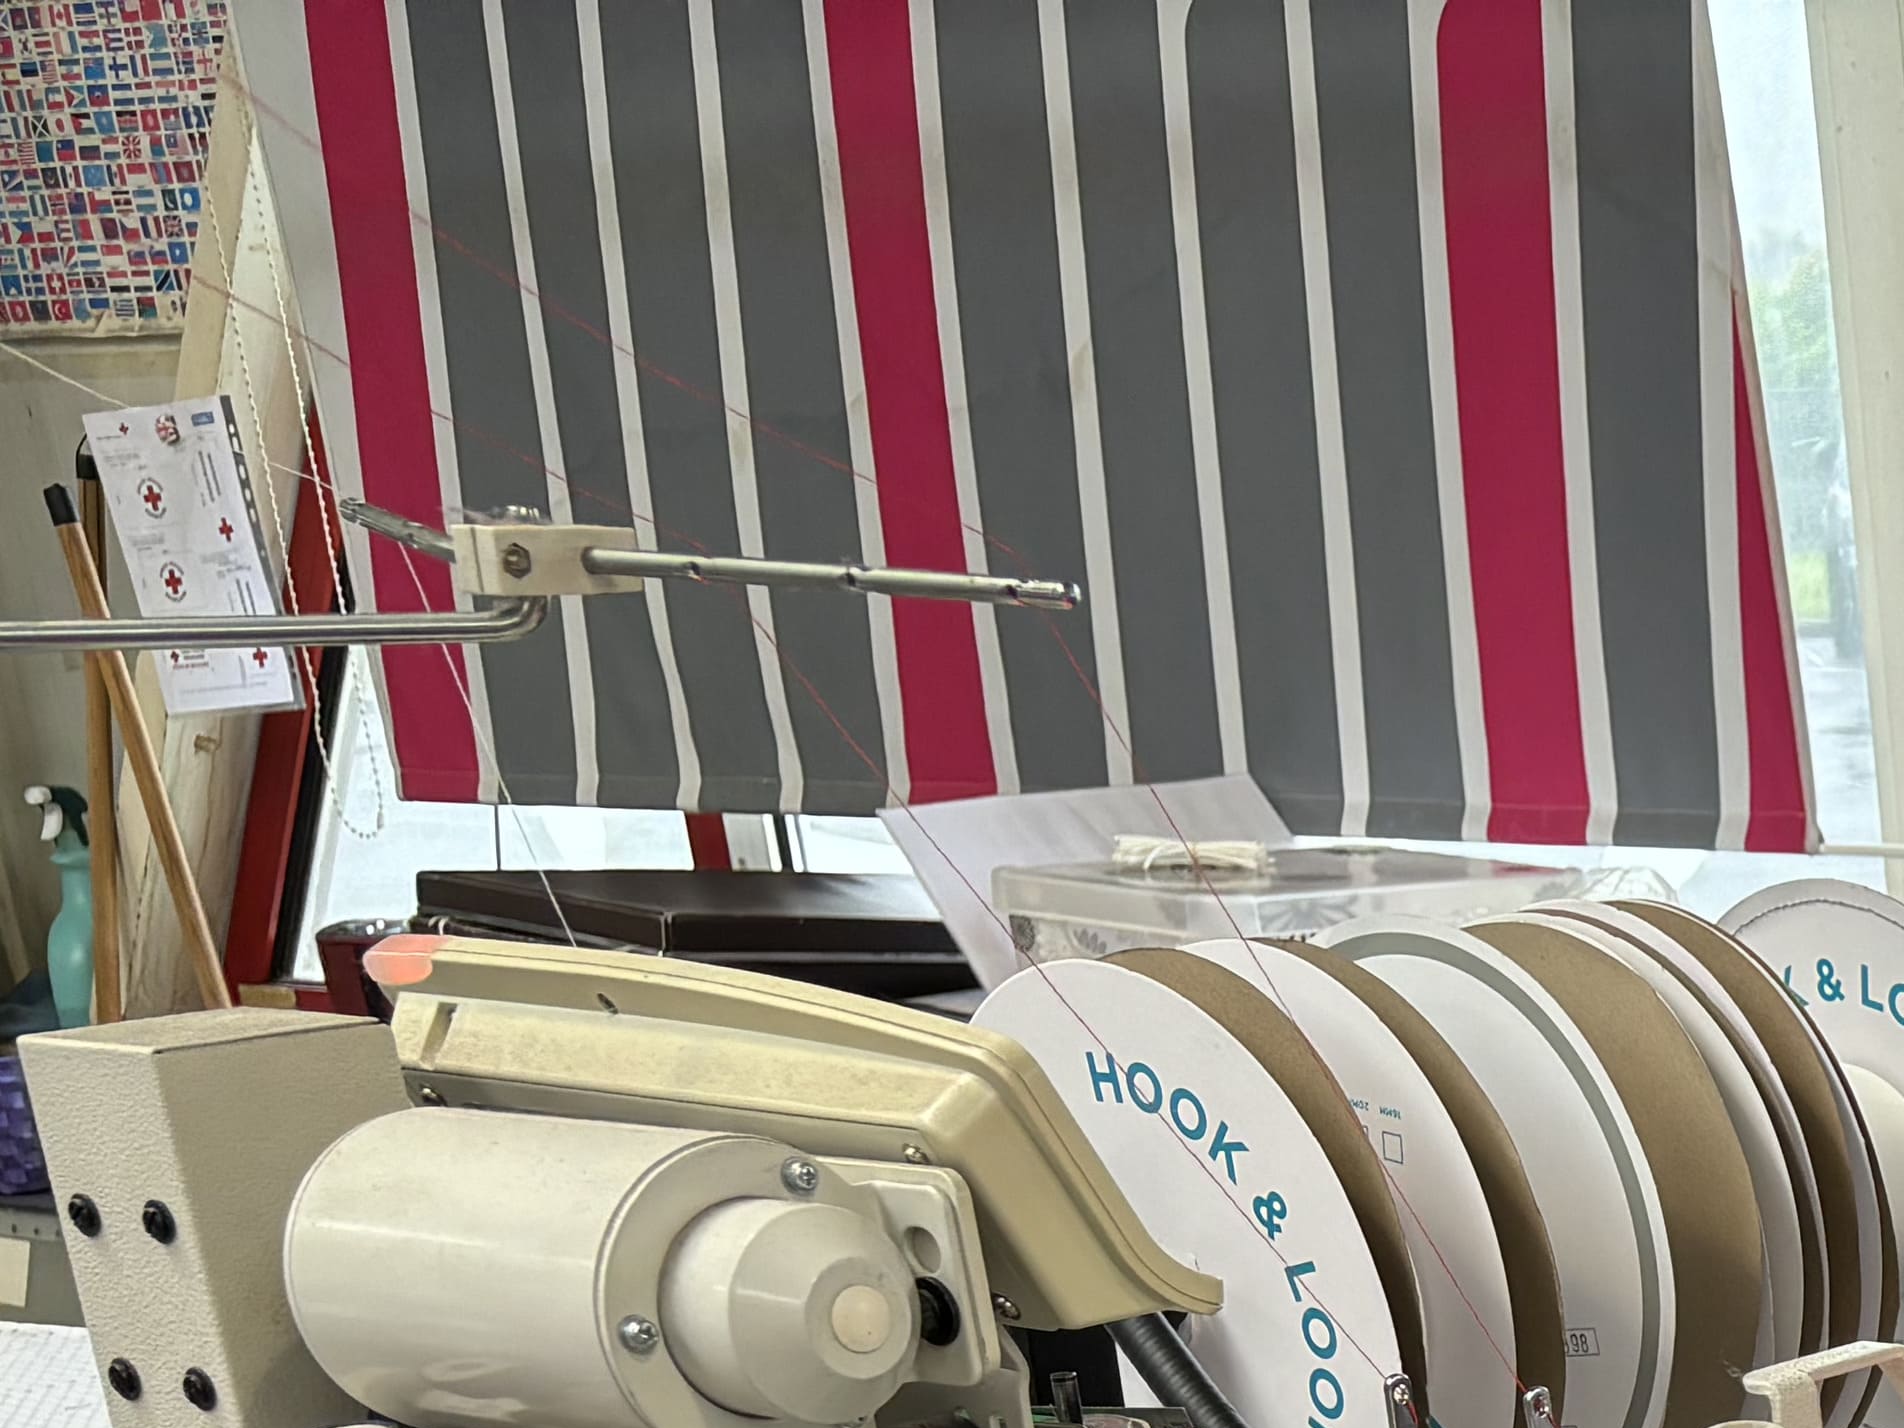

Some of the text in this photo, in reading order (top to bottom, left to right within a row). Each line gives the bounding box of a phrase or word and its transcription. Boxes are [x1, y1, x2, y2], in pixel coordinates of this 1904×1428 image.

[1816, 958, 1846, 1003] &
[1085, 1050, 1250, 1186] HOOK
[1252, 1190, 1288, 1241] &
